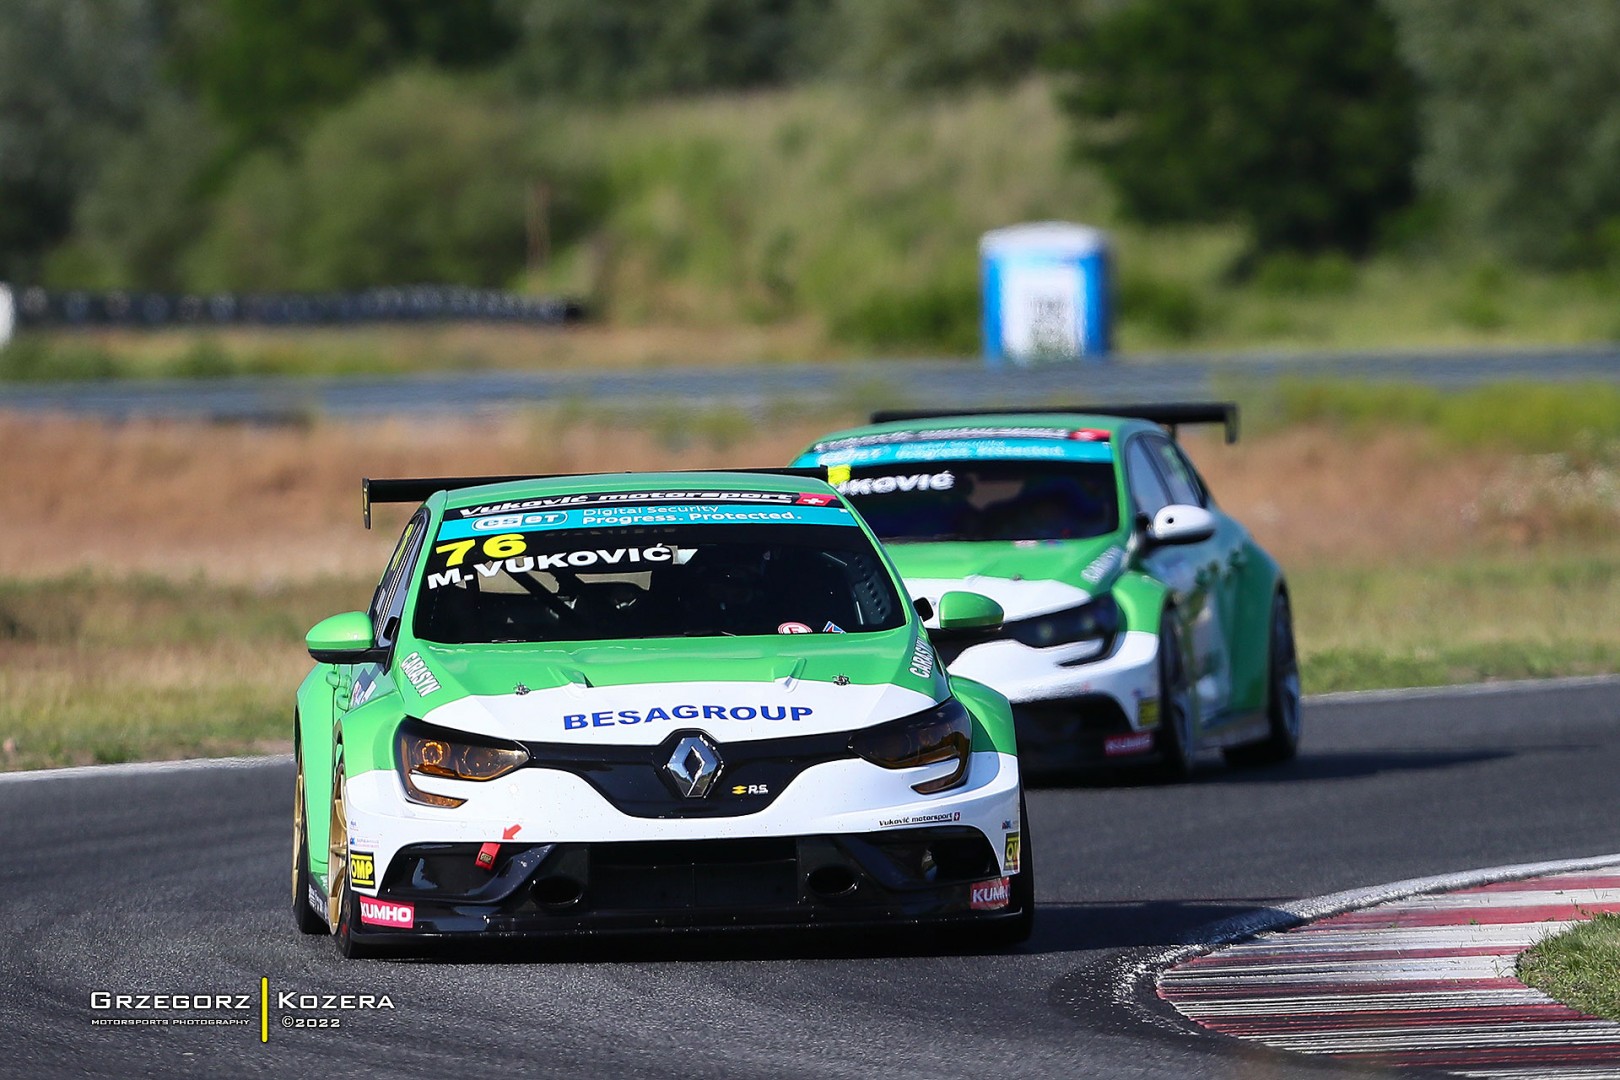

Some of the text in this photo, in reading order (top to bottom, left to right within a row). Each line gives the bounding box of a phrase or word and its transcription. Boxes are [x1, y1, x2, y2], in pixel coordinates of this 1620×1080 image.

[460, 491, 793, 516] Vuković motorsport
[583, 505, 719, 517] Digital Security
[582, 511, 802, 525] Progress. Protected.
[436, 533, 527, 567] 76
[427, 543, 671, 589] M.VUKOVIĆ
[400, 652, 442, 698] CARASYN
[564, 705, 813, 730] BESAGROUP
[911, 812, 952, 823] motorsport
[351, 859, 373, 880] OMP
[360, 902, 412, 922] KUMHO
